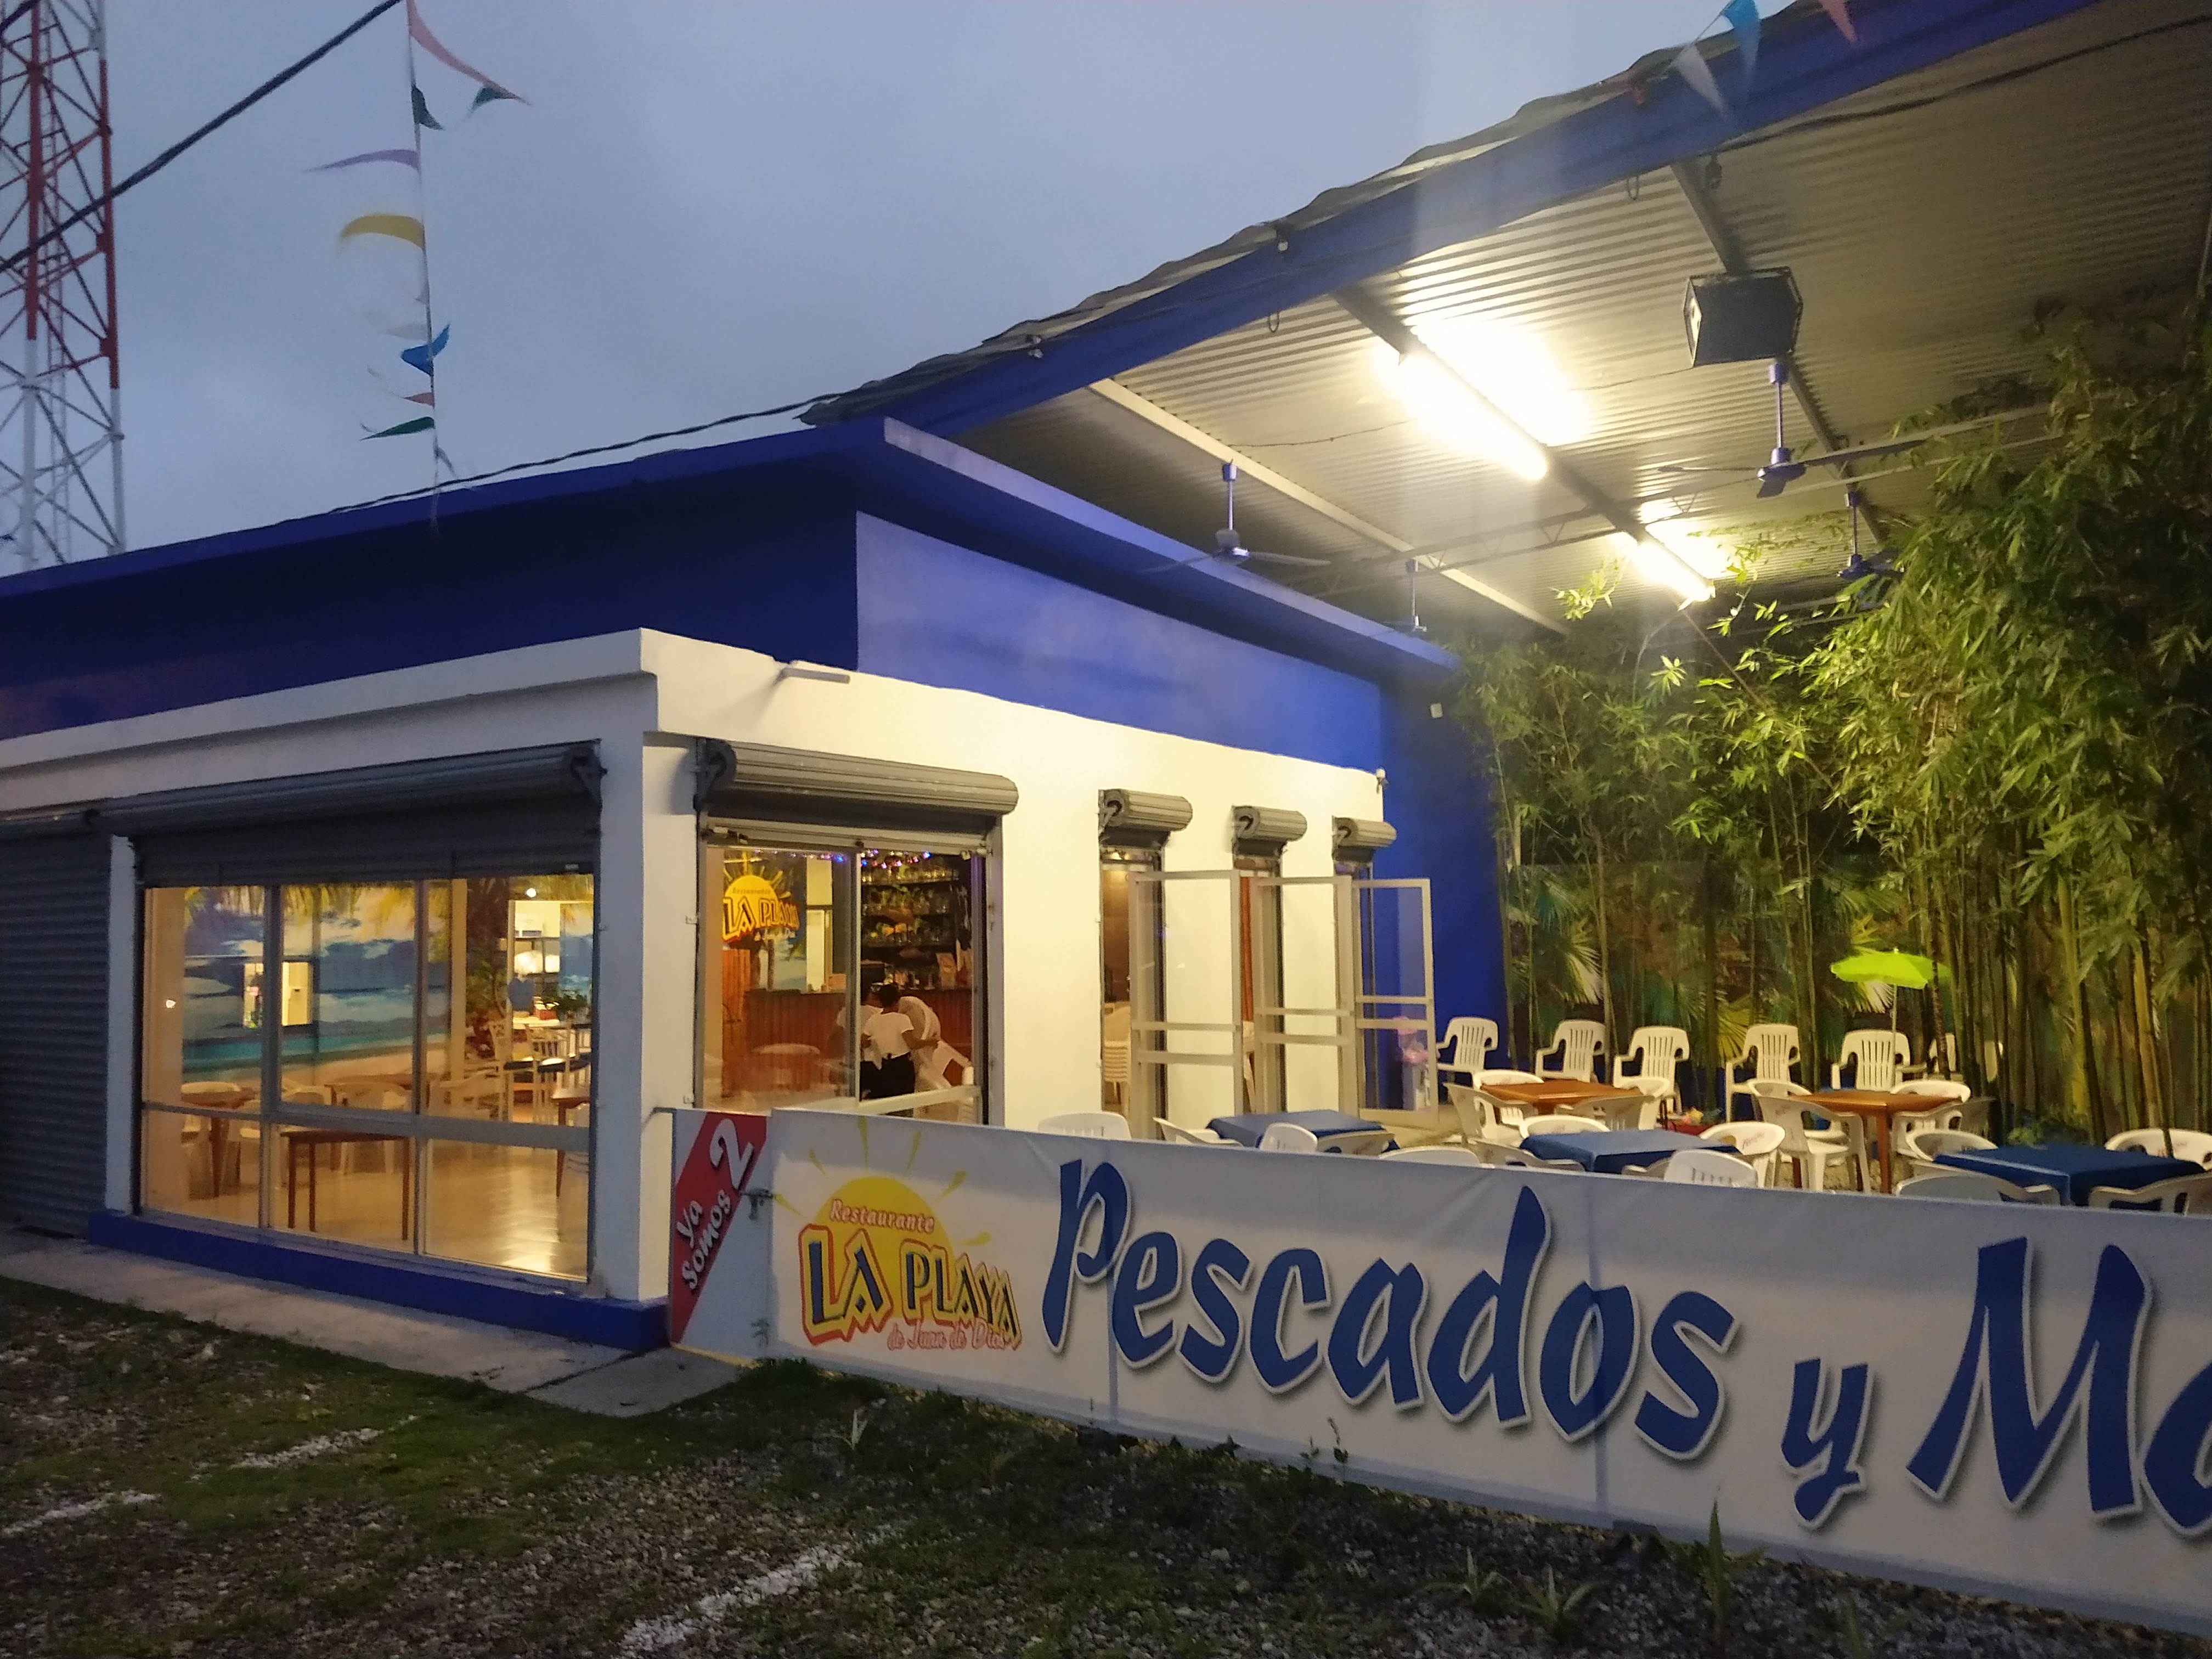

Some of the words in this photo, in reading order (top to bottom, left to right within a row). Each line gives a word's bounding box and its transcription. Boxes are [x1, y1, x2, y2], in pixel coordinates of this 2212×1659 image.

[723, 896, 756, 941] LA
[709, 1118, 754, 1190] 2
[676, 1200, 703, 1249] Ya
[830, 1198, 935, 1234] Restaurante
[802, 1226, 890, 1341] LA
[902, 1243, 1020, 1345] PLAYA
[887, 1322, 905, 1351] de
[907, 1318, 947, 1350] Juan
[950, 1318, 967, 1350] de
[1041, 1158, 1737, 1459] Pescados
[1780, 1356, 1869, 1524] y
